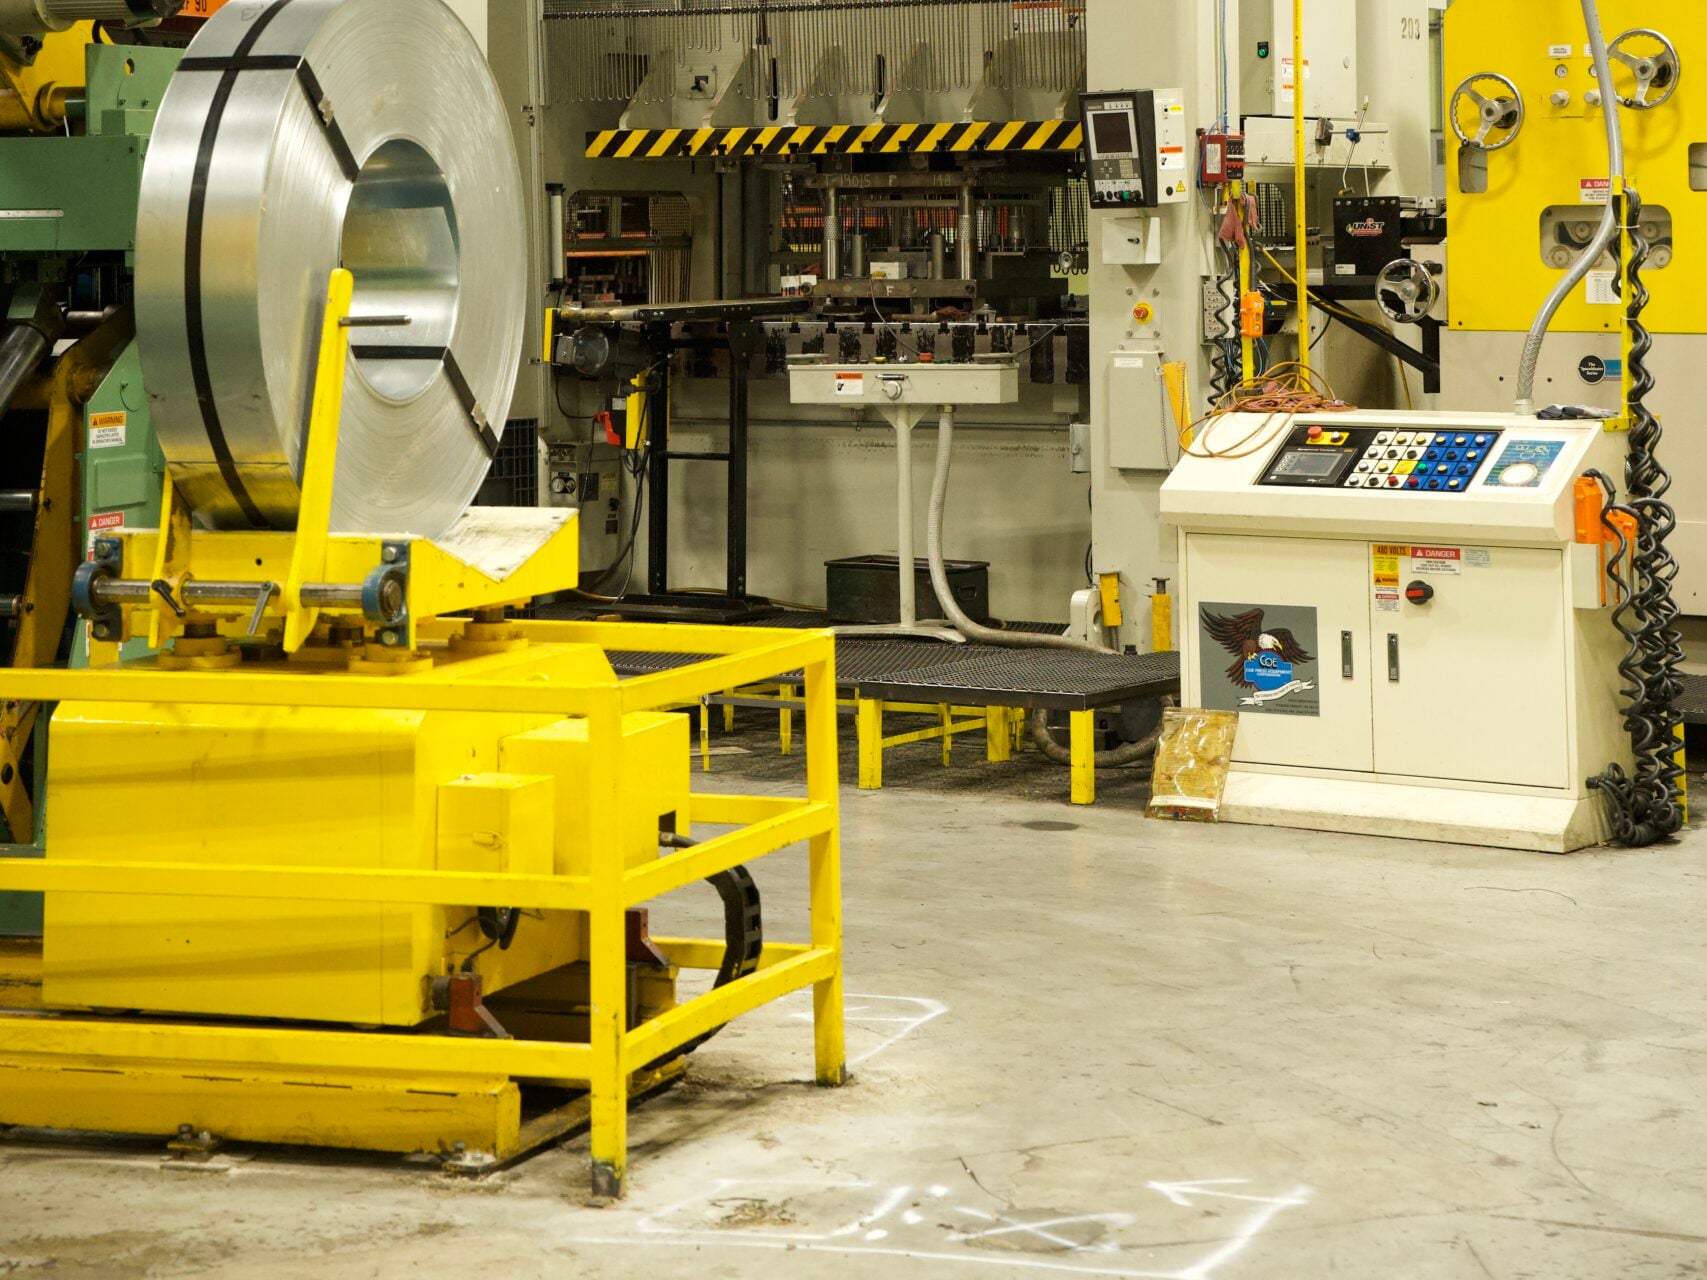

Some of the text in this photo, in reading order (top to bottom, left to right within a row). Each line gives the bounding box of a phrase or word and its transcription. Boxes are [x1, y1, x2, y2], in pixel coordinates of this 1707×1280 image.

[1401, 16, 1420, 40] 203
[886, 285, 894, 297] F
[98, 415, 123, 425] WARNING
[98, 516, 120, 527] DANGER
[1390, 546, 1406, 556] VOLTS
[1425, 549, 1456, 558] DANGER
[1259, 654, 1278, 668] COE
